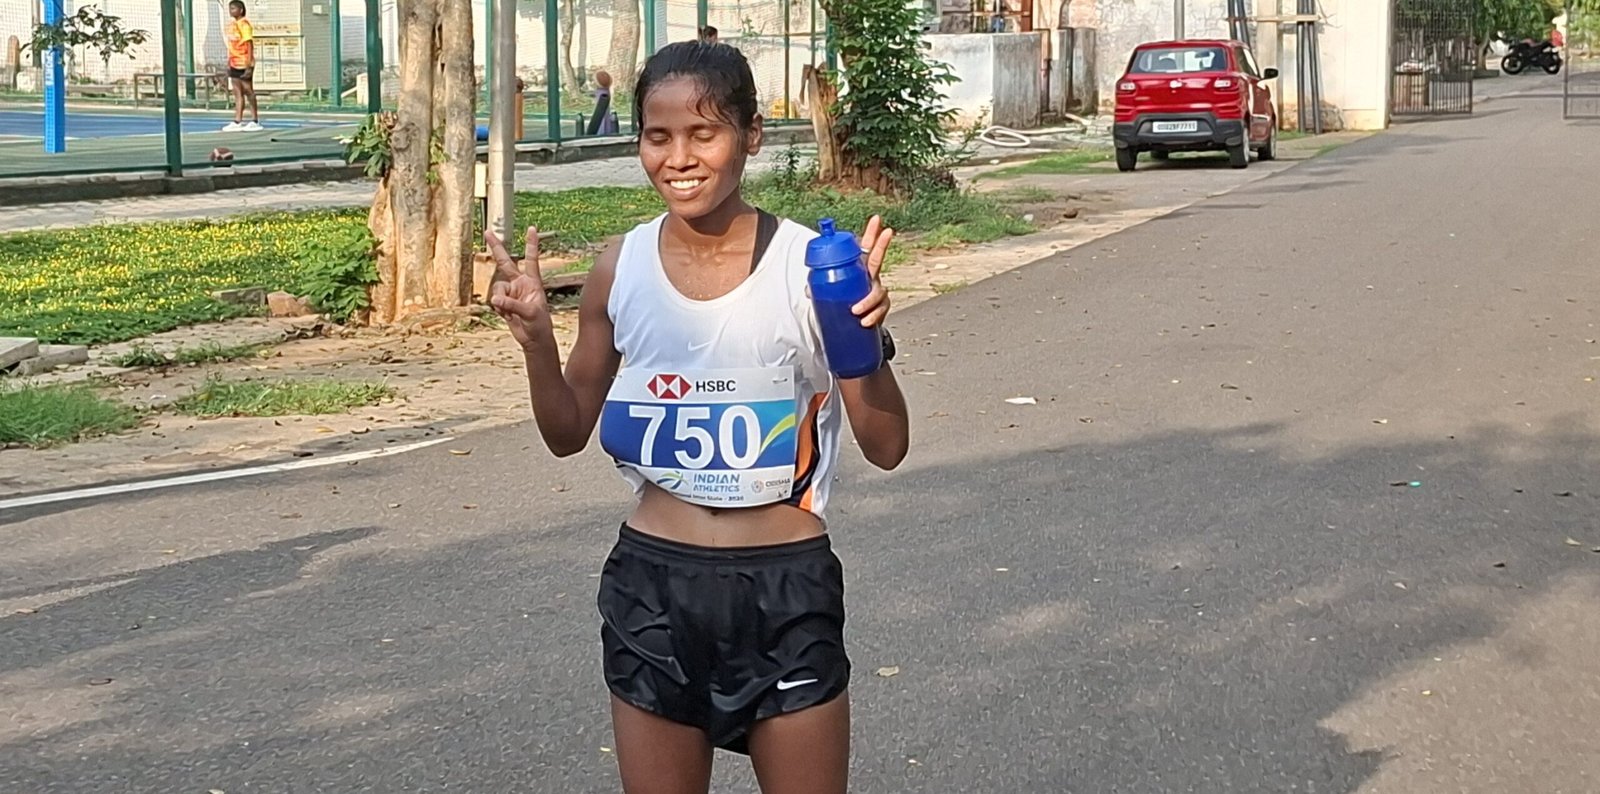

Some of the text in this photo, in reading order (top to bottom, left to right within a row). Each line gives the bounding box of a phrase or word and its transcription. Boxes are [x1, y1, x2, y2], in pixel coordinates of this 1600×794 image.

[695, 380, 737, 393] HSBC
[628, 404, 762, 470] 750
[693, 473, 741, 484] INDIAN
[693, 484, 740, 493] ATHLETICS
